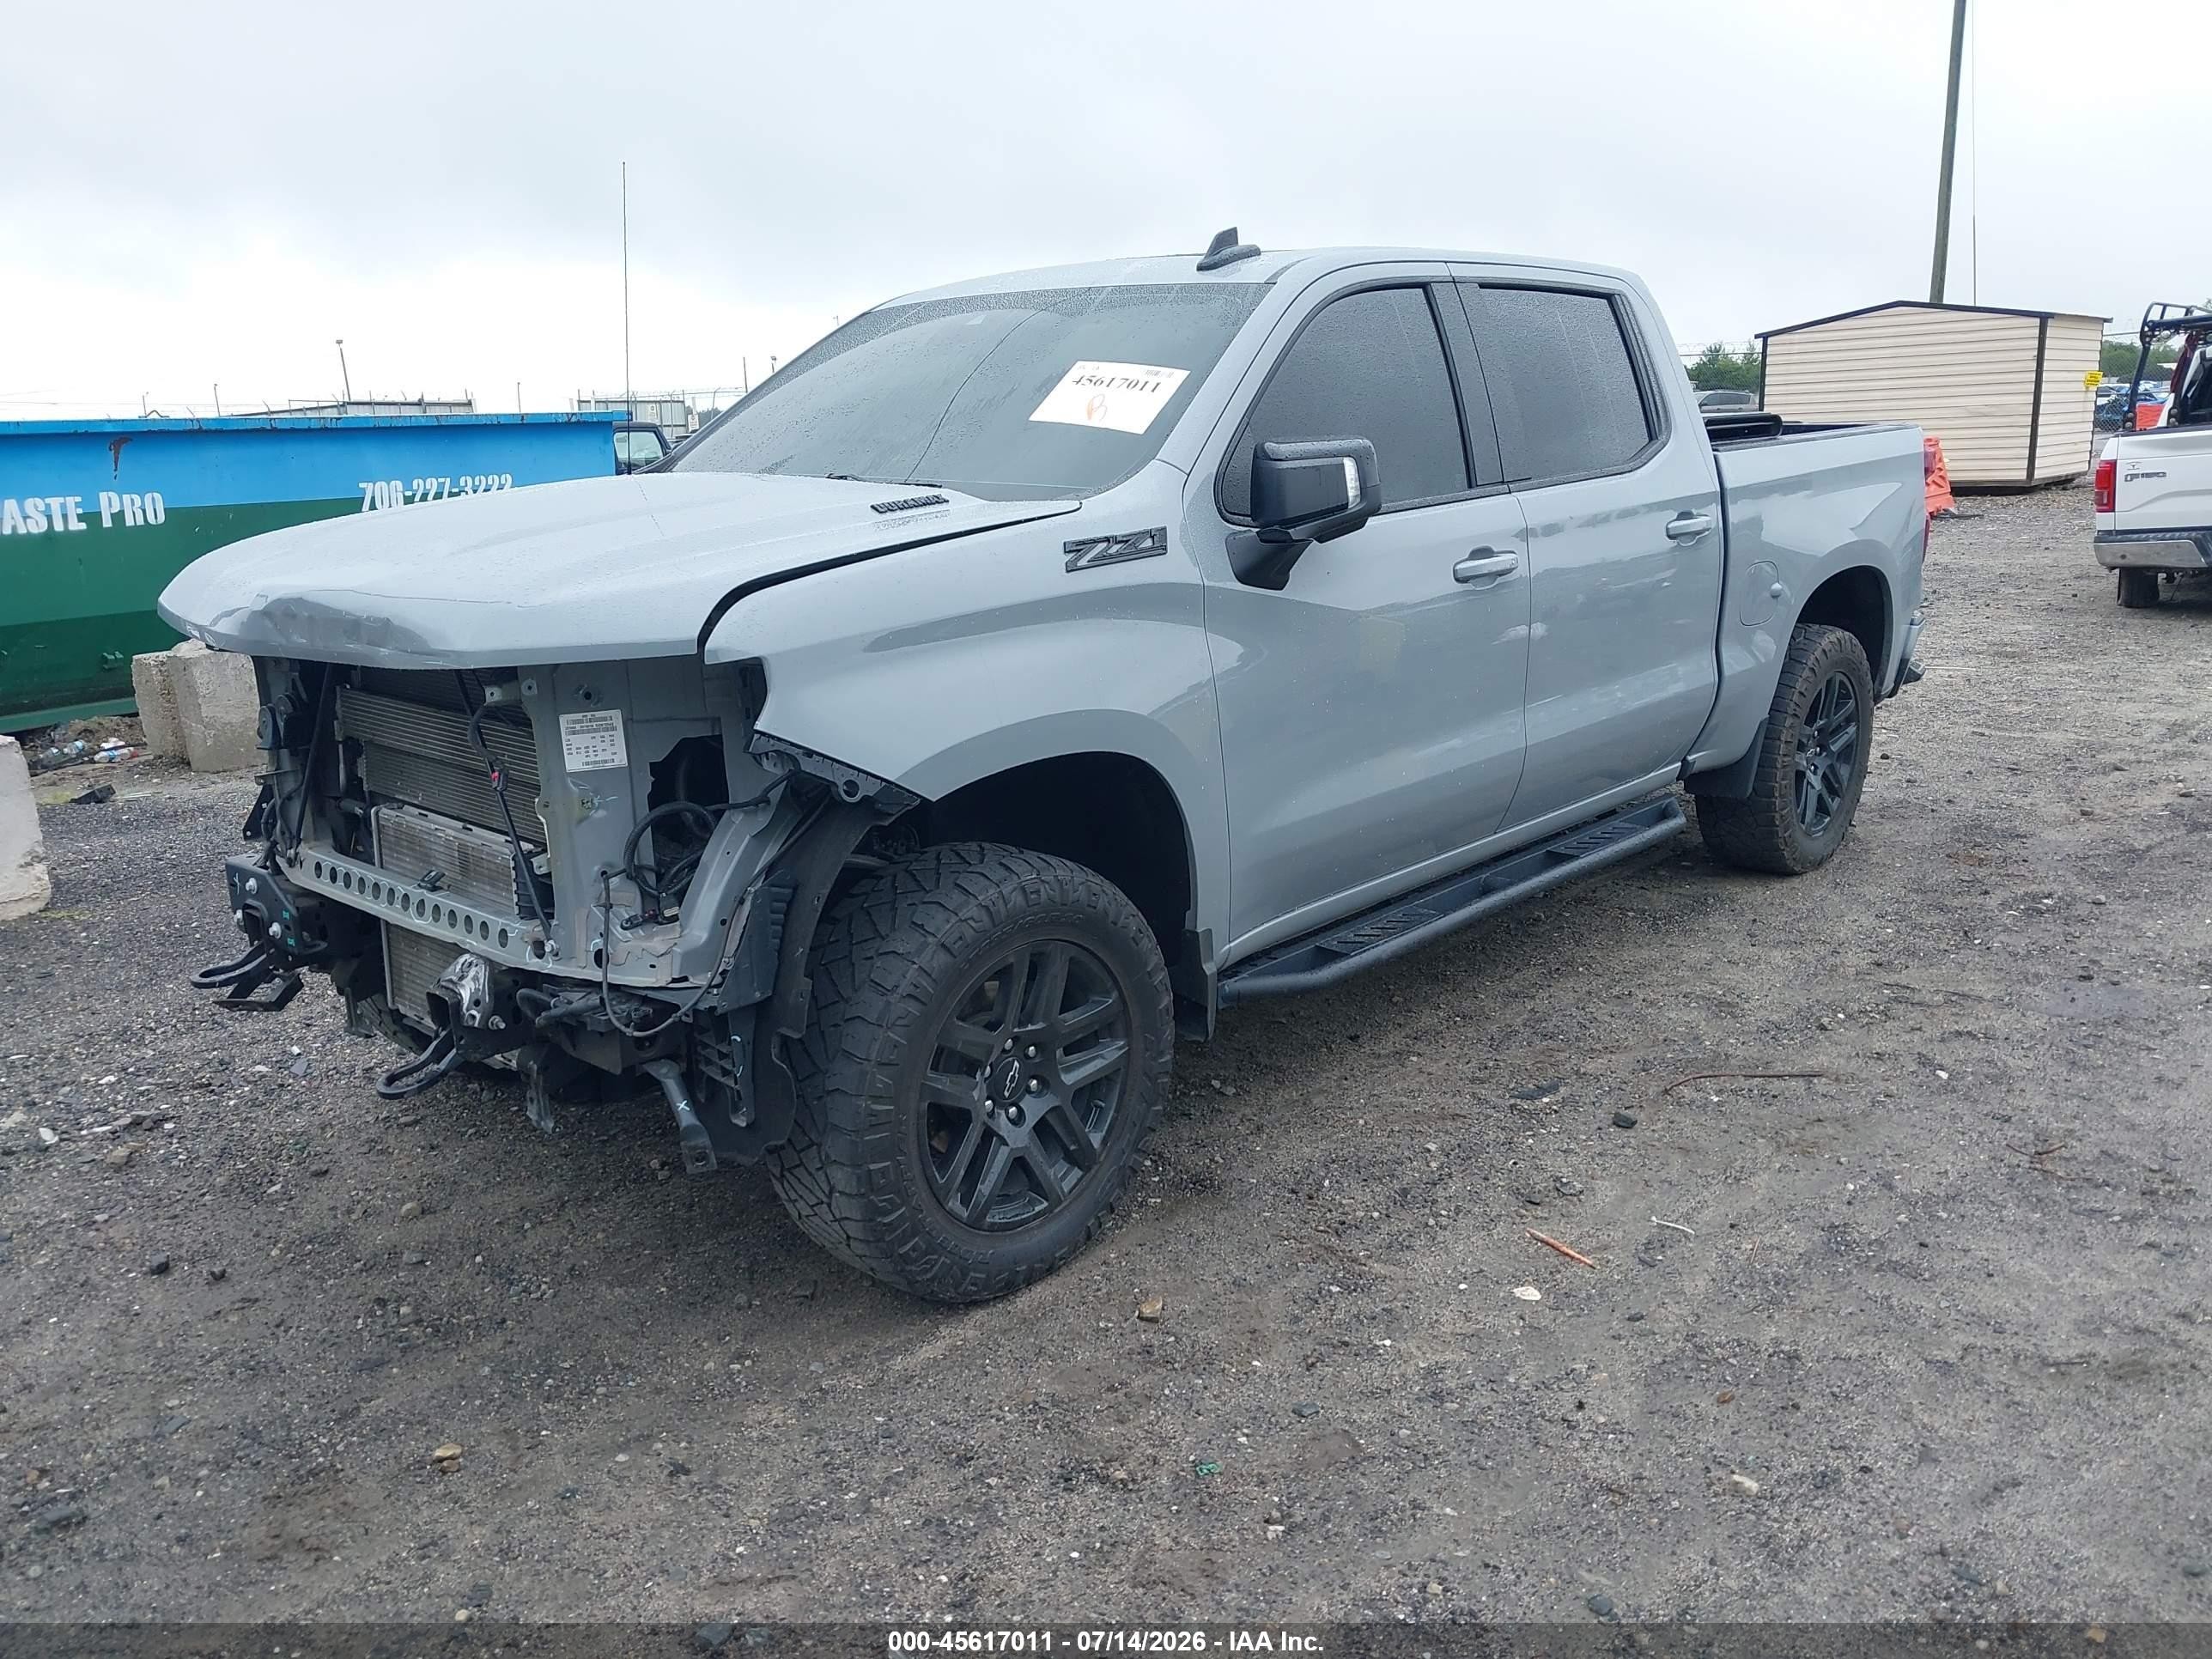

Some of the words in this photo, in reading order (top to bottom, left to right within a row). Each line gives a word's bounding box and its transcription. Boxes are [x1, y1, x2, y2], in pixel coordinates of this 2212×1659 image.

[1072, 374, 1162, 393] 45617011
[0, 495, 88, 535] ASTE
[99, 490, 166, 528] PRO
[1063, 525, 1169, 574] Z71
